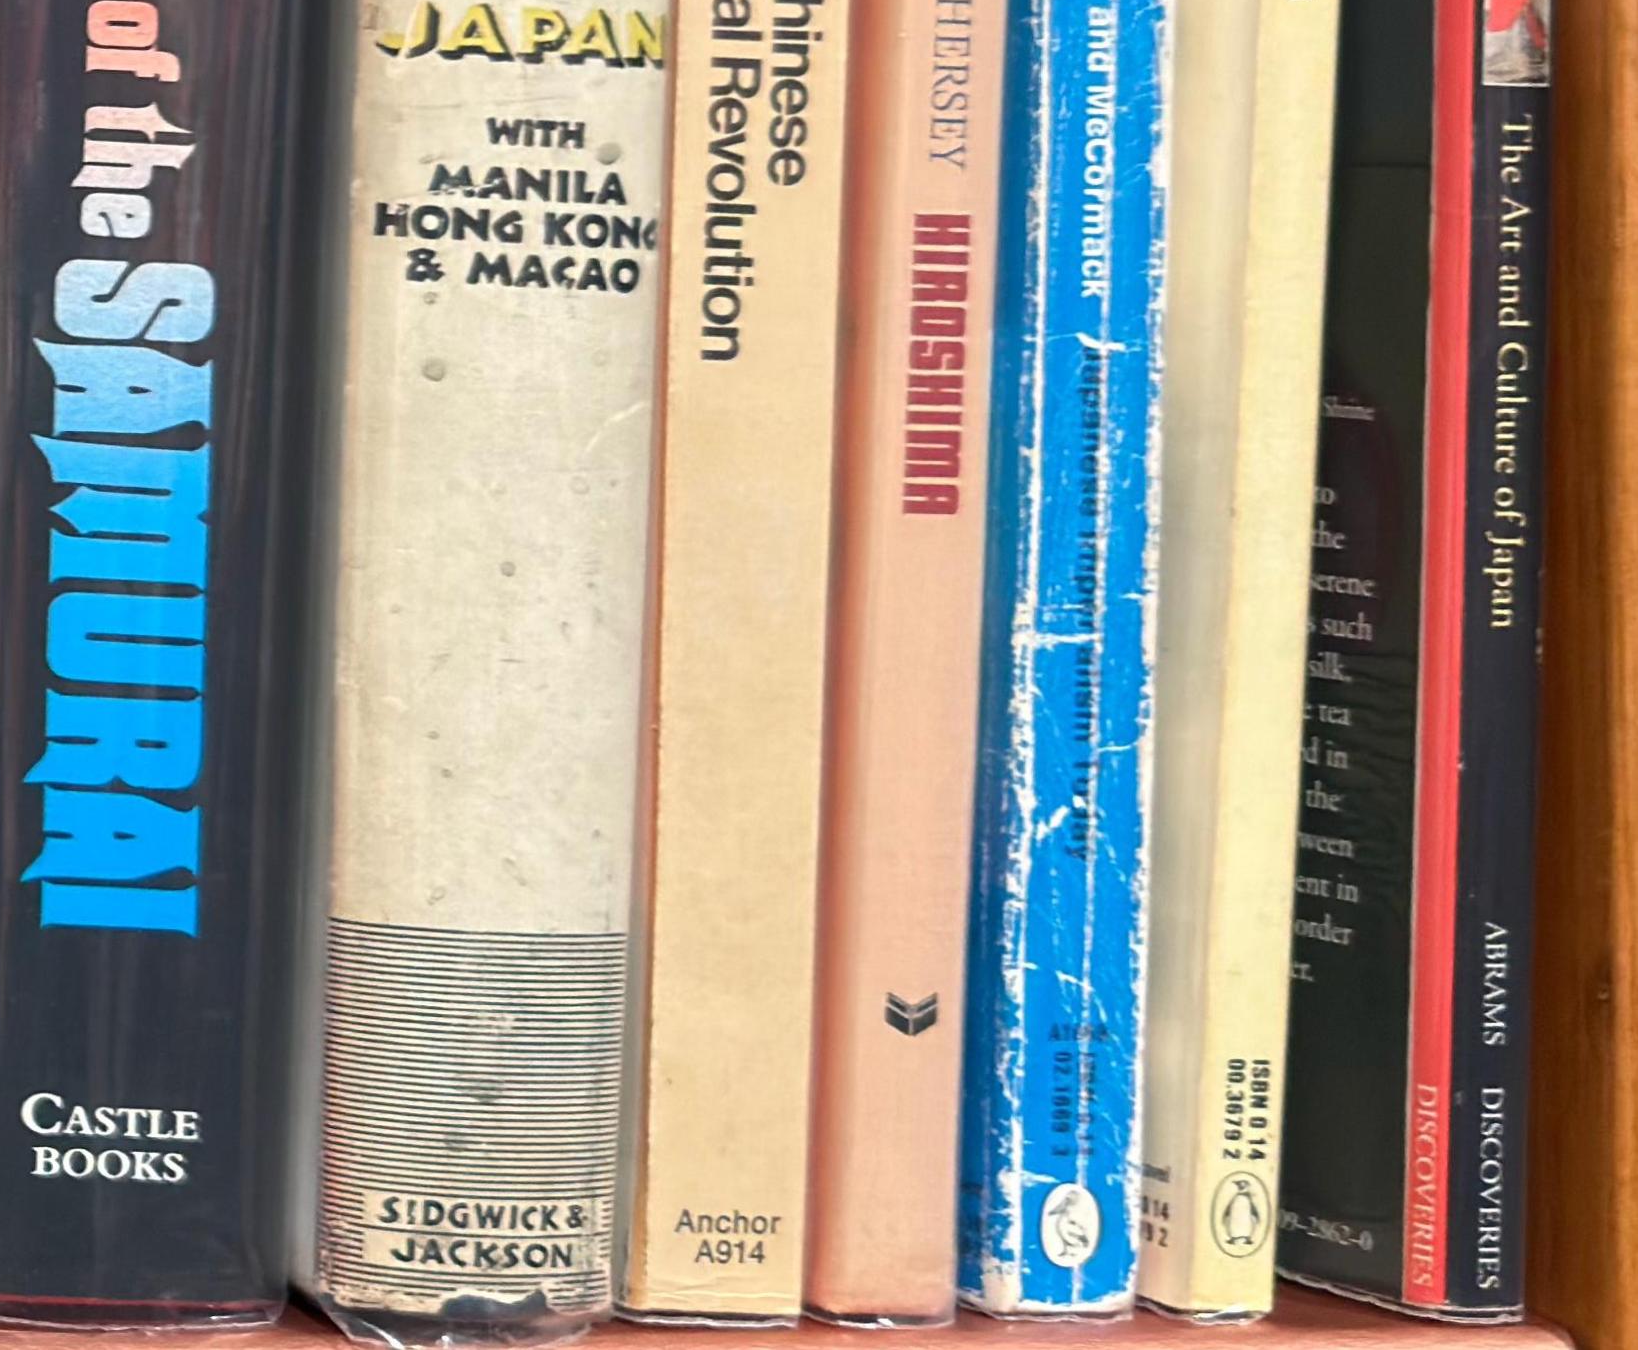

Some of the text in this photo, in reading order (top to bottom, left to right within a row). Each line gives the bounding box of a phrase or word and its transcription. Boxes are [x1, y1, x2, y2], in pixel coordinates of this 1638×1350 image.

[84, 0, 182, 84] of
[376, 1, 666, 69] JAPAN
[1087, 6, 1118, 72] and
[487, 117, 585, 149] WITH
[71, 105, 196, 240] the
[428, 164, 627, 205] MANILA
[1080, 83, 1116, 299] McCormack
[374, 202, 523, 243] HONG
[700, 56, 763, 362] Revolution
[406, 248, 640, 293] & MACAO
[902, 213, 973, 515] HIROSHIMA
[1482, 112, 1533, 629] The Art and Culture of Japan
[21, 258, 216, 938] SAMURAI
[1321, 612, 1372, 641] such
[1306, 780, 1343, 811] the
[1482, 921, 1510, 1046] ABRAMS
[1247, 1059, 1271, 1160] ISBN 14
[31, 1147, 186, 1183] BOOKS
[1412, 1082, 1440, 1288] DISCOVERIES
[1476, 1086, 1506, 1291] DISCOVERIES
[379, 1196, 551, 1231] SIDGWICK
[674, 1208, 781, 1235] Anchor
[391, 1237, 573, 1269] JACKSON
[693, 1240, 765, 1264] A914
